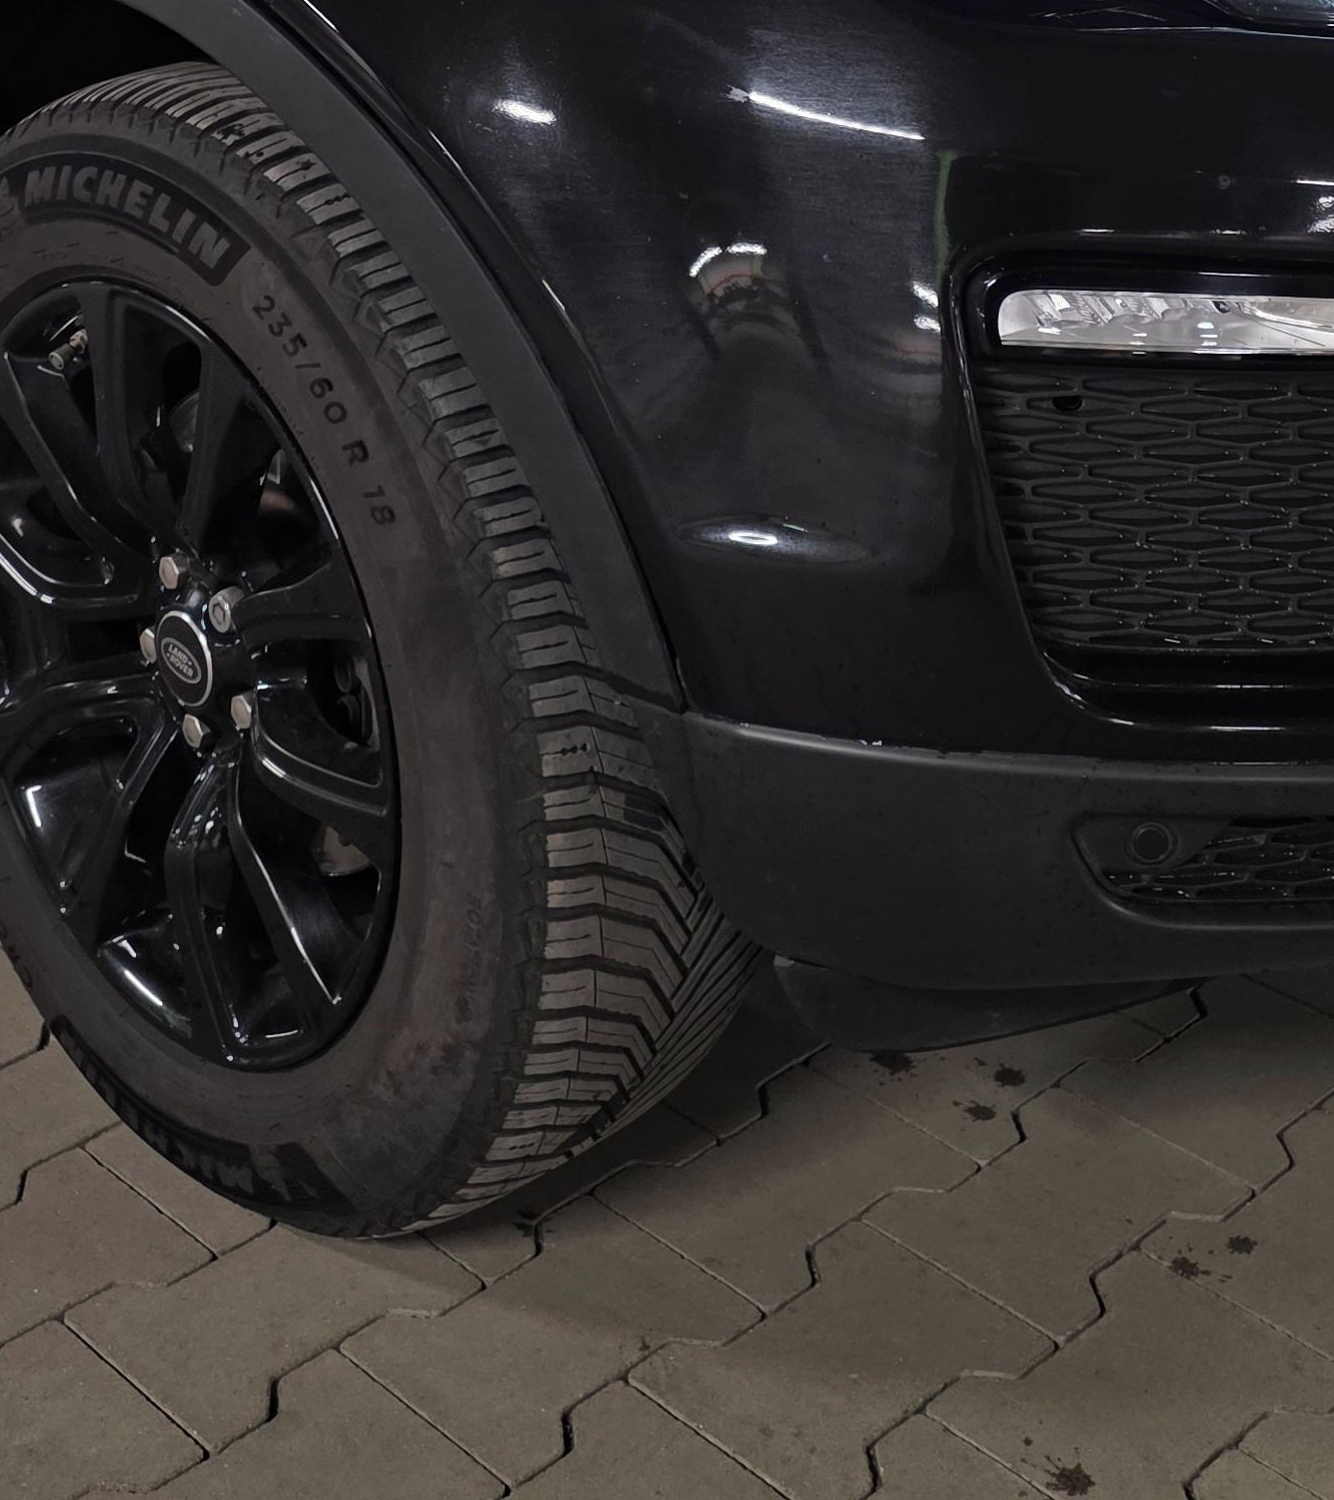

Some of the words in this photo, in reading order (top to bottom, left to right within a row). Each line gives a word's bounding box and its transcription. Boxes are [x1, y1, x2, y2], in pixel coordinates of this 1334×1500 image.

[24, 165, 232, 269] MICHELIN
[252, 295, 348, 425] 235/60
[341, 439, 369, 468] R
[362, 484, 397, 526] 18
[169, 644, 188, 664] LAND
[170, 655, 194, 677] ROVER
